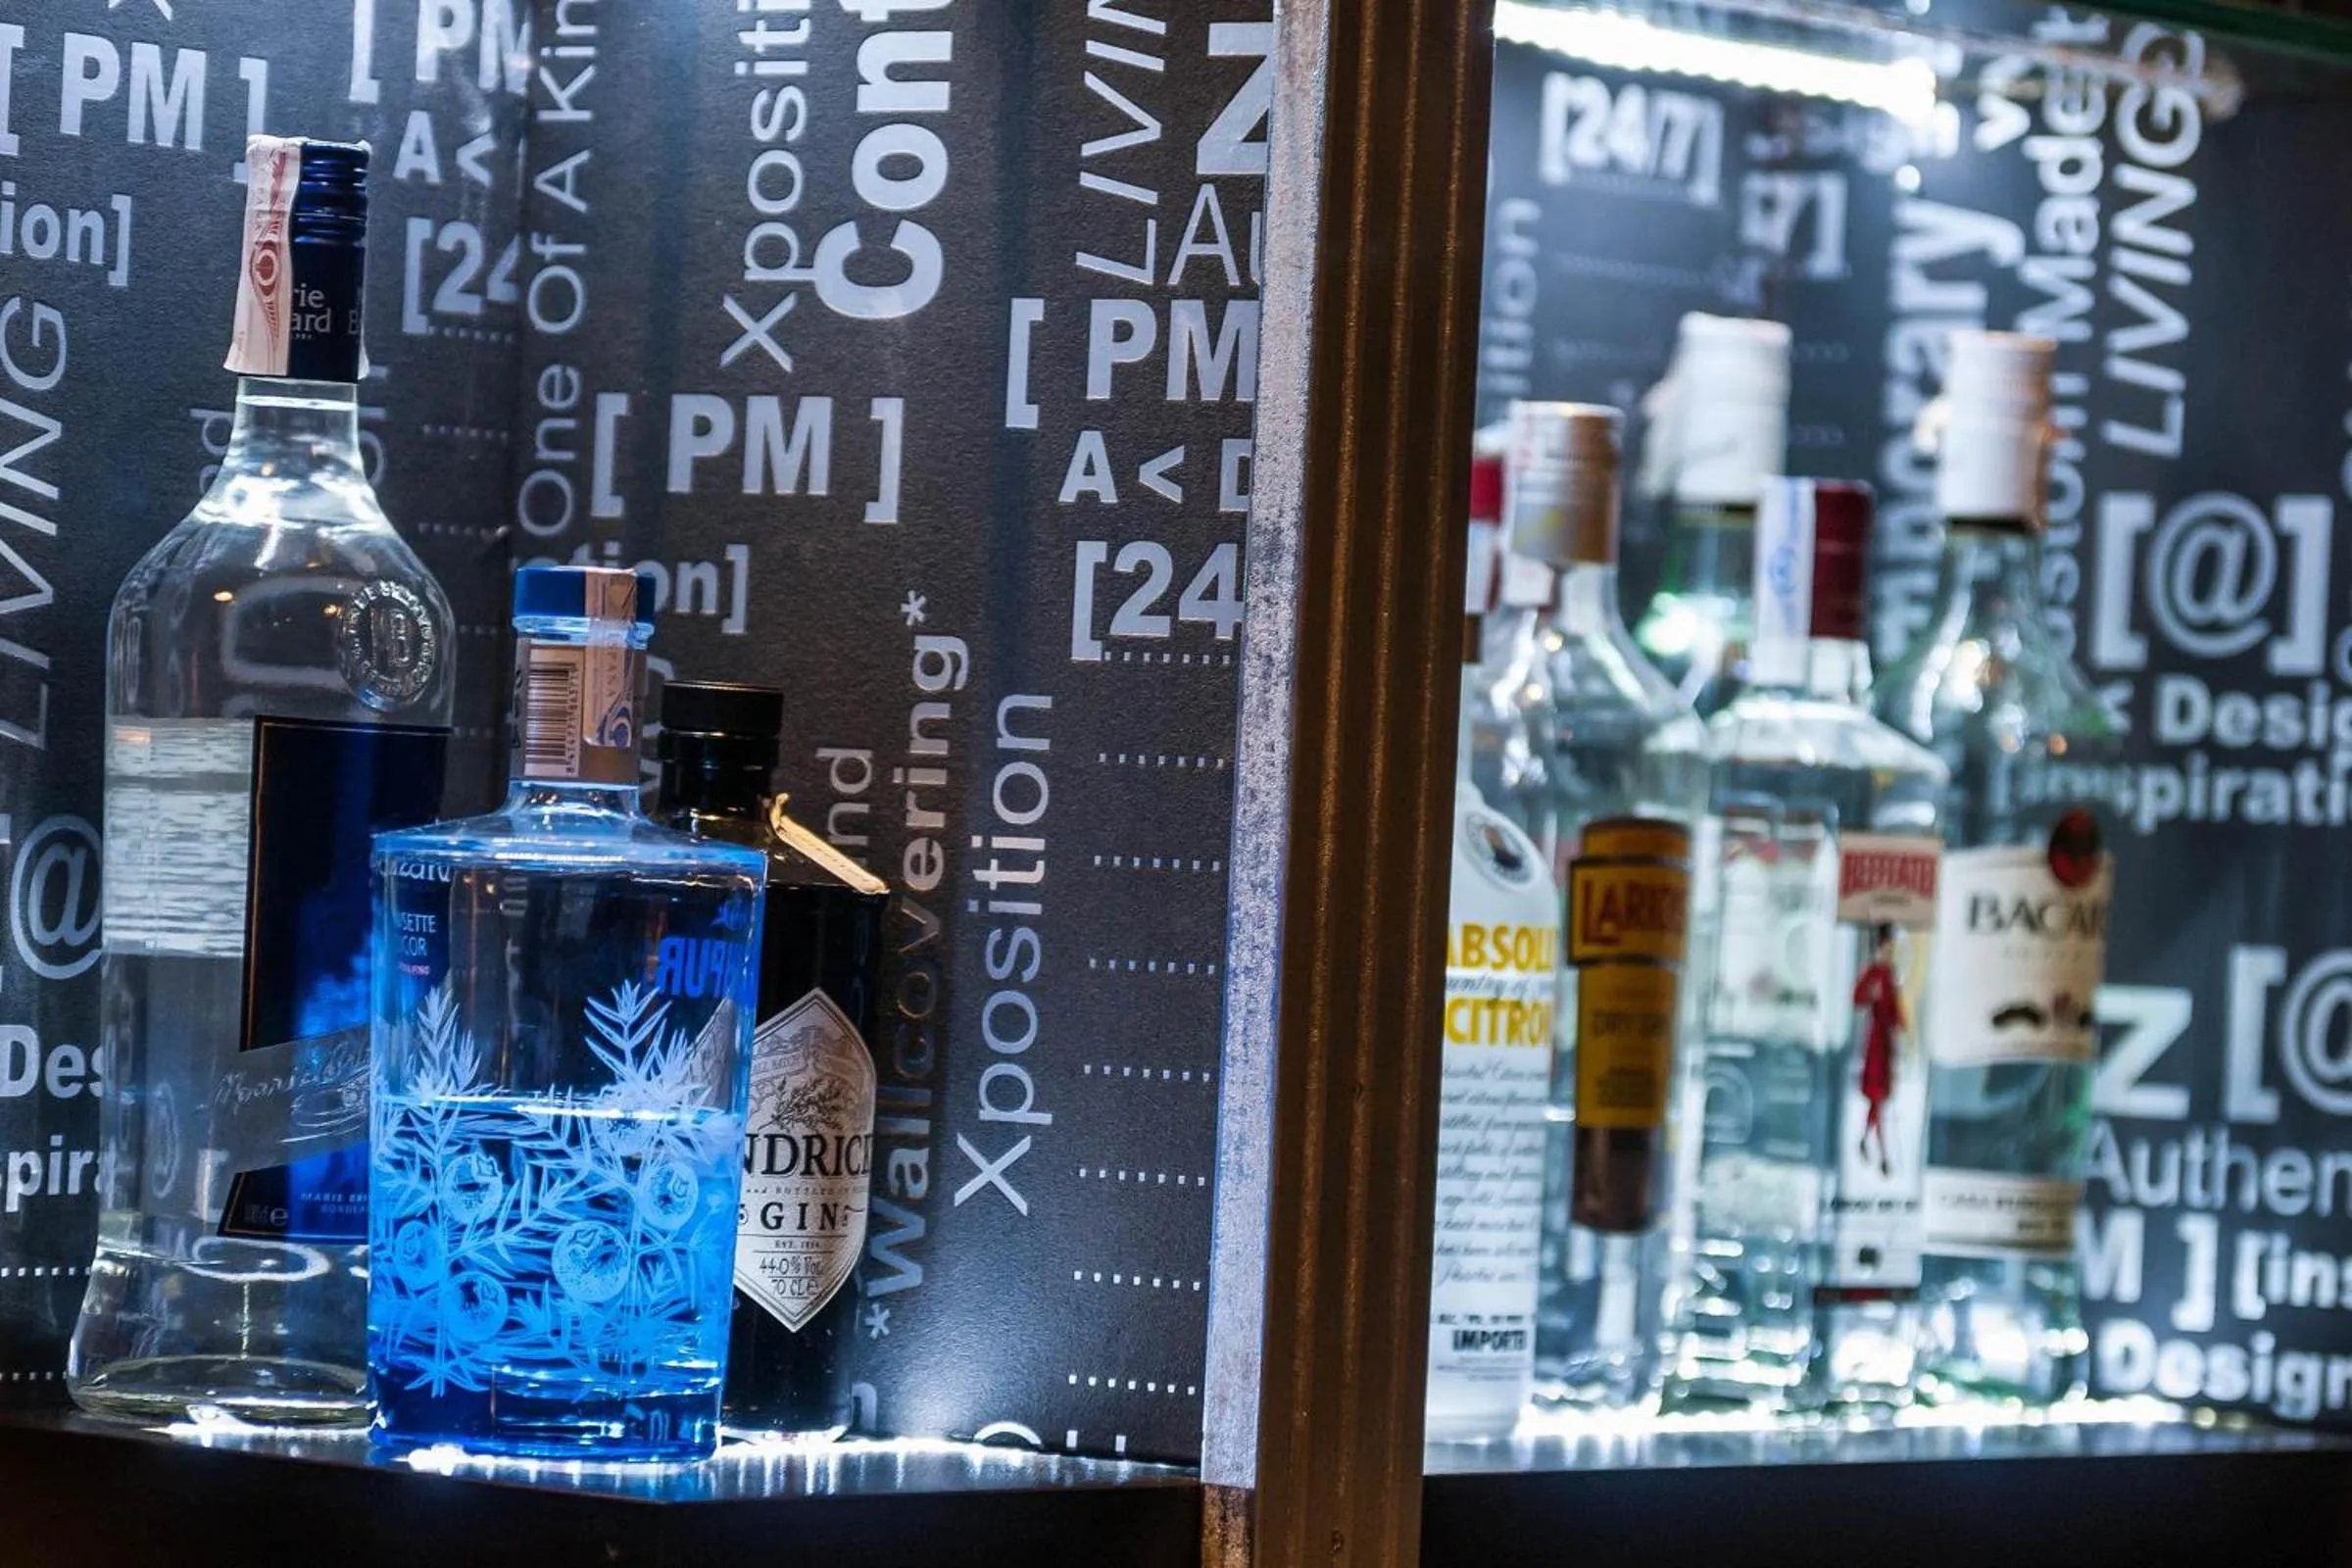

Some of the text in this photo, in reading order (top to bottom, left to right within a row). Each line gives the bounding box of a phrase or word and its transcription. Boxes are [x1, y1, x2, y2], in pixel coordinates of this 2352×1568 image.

[60, 32, 207, 151] PM
[1196, 22, 1275, 174] Z
[534, 148, 590, 214] A
[527, 230, 586, 333] Of
[1085, 298, 1258, 402] PM
[517, 364, 581, 536] One
[667, 394, 832, 496] PM
[2091, 492, 2334, 676] [@]
[954, 690, 1053, 1217] Xposition
[2091, 982, 2193, 1120] Z
[760, 1201, 838, 1232] GIN
